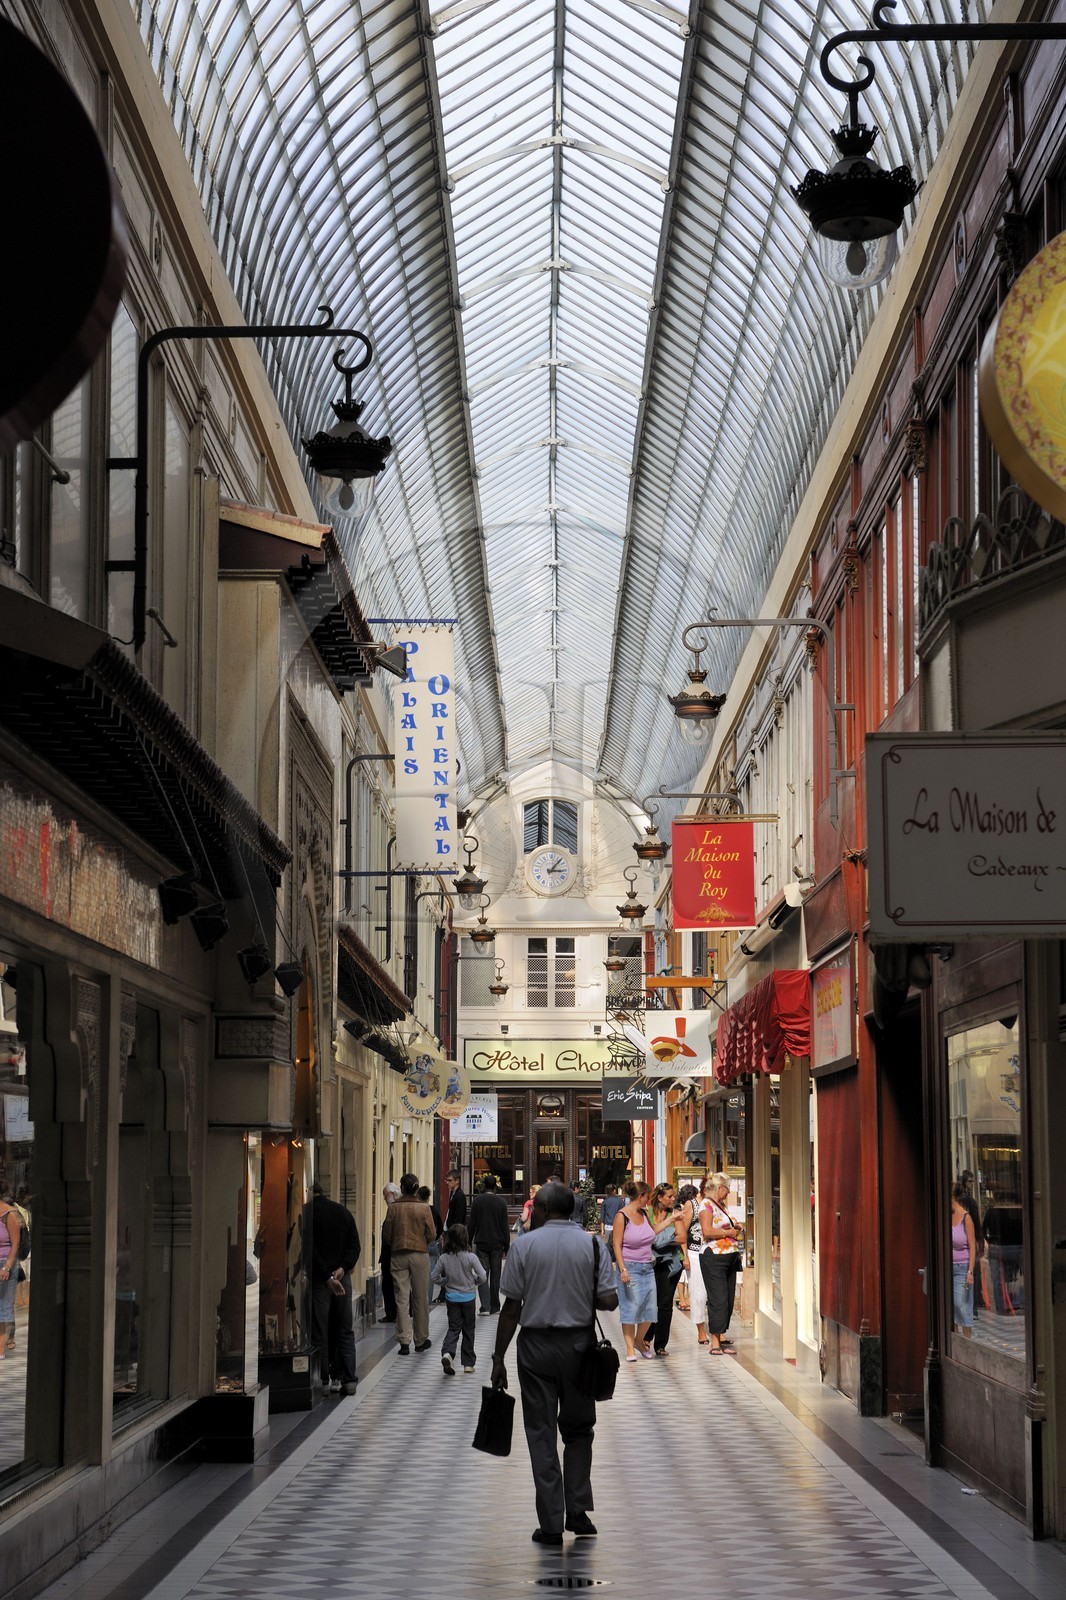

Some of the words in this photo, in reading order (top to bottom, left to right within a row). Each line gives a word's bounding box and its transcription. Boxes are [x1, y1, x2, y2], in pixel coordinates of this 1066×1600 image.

[398, 641, 419, 775] PALAIS
[428, 674, 451, 855] ORIENTAL
[903, 787, 939, 836] La
[949, 787, 1028, 836] Maison
[1036, 786, 1057, 834] de
[701, 830, 722, 845] La
[684, 848, 740, 862] Maison
[704, 864, 722, 880] du
[968, 855, 1049, 892] Cadeaux
[698, 882, 728, 900] Roy
[472, 1050, 544, 1072] Hôtel
[607, 1090, 624, 1102] Eric
[624, 1088, 654, 1106] Stipa
[474, 1145, 511, 1159] HOTEL
[539, 1145, 563, 1154] HOTEL
[592, 1145, 629, 1159] HOTEL
